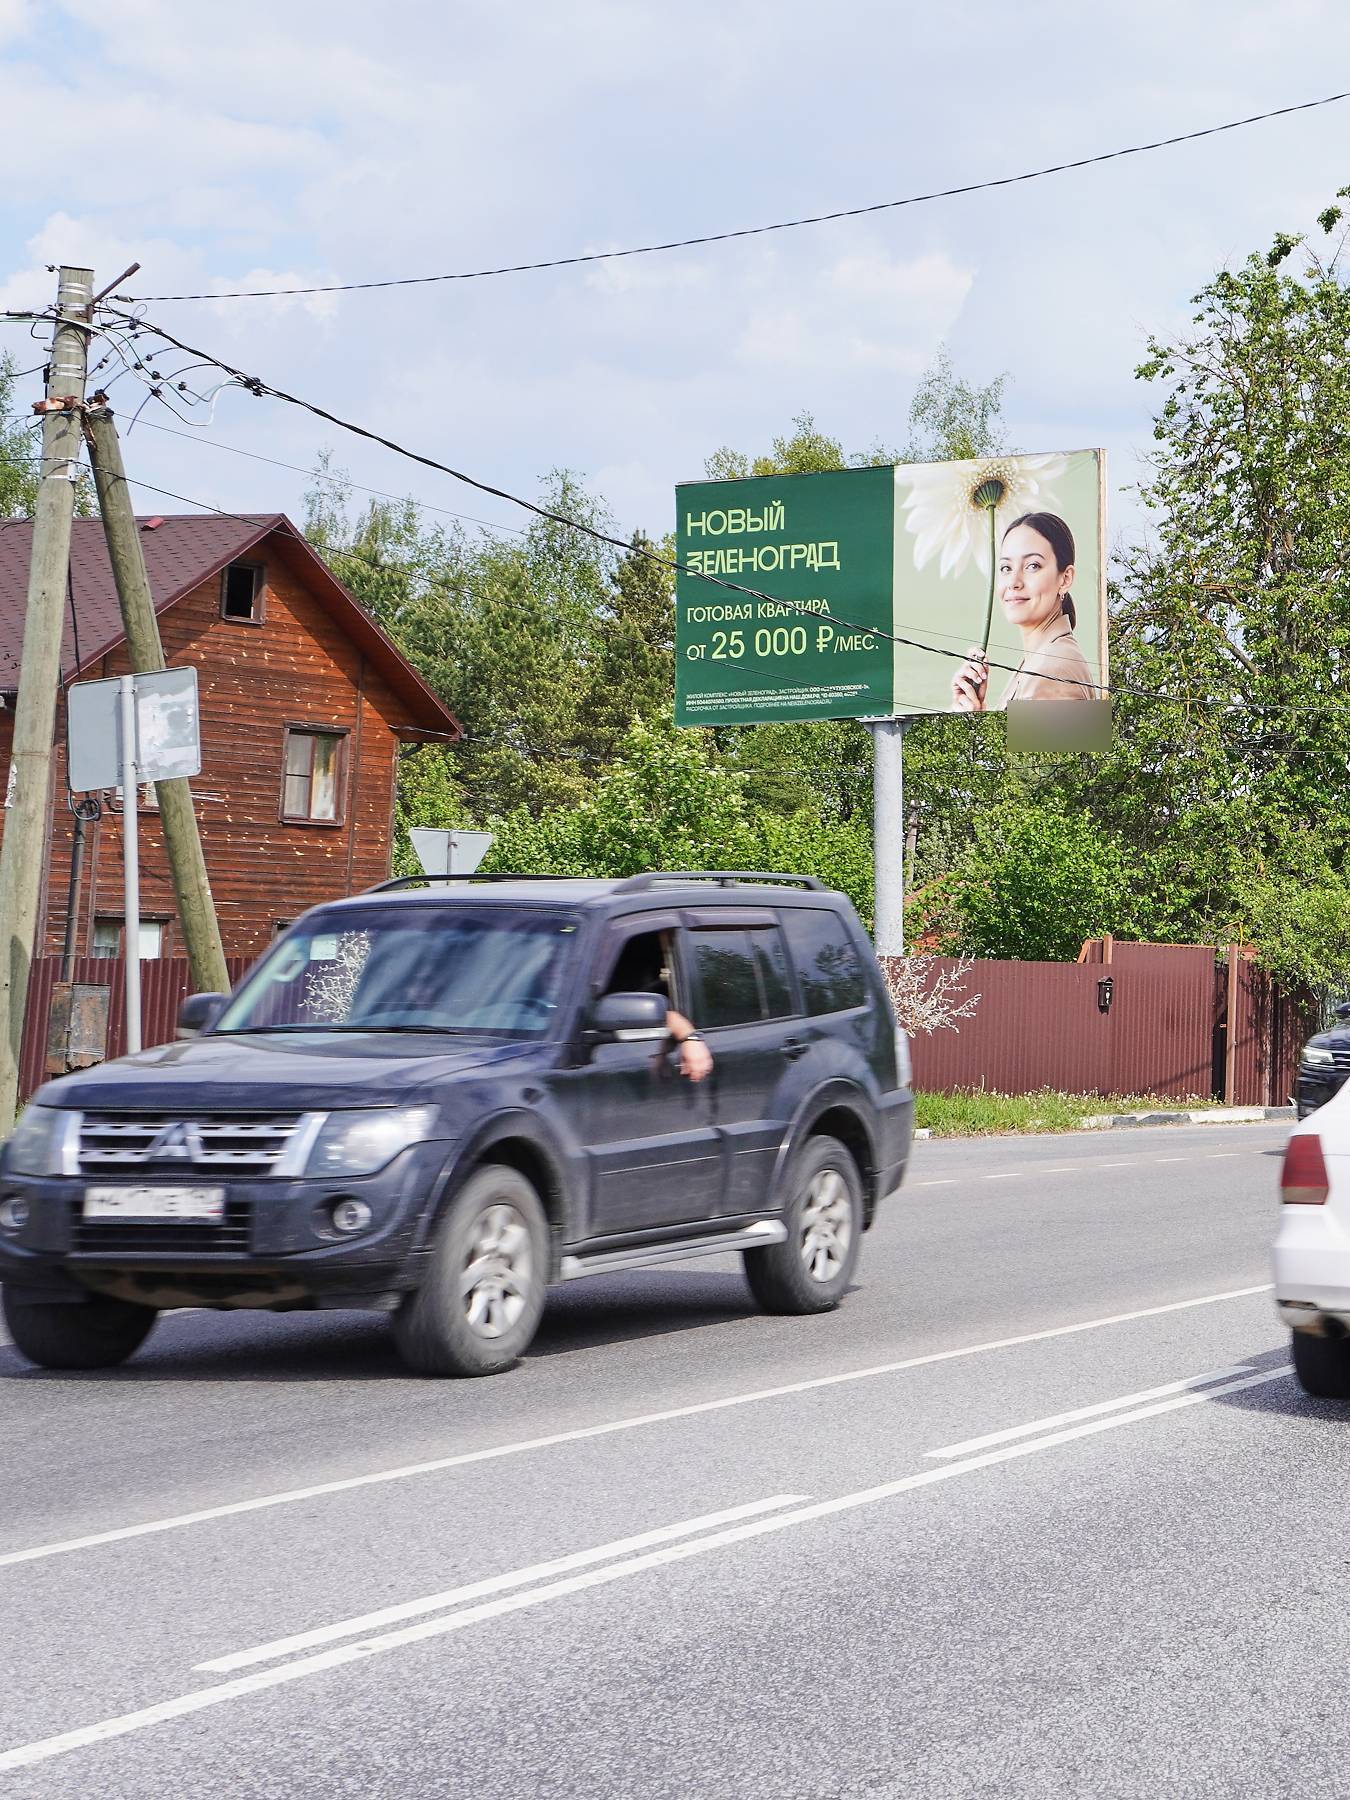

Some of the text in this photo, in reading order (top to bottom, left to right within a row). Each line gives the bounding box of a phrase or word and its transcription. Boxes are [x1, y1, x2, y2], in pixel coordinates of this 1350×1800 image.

[687, 500, 785, 536] НОВЫЙ
[686, 541, 841, 576] ЗЕЛЕНОГРАД
[687, 599, 831, 623] ГОТОВАЯ КВАРТИРА
[711, 631, 745, 660] 25
[755, 626, 807, 657] 000
